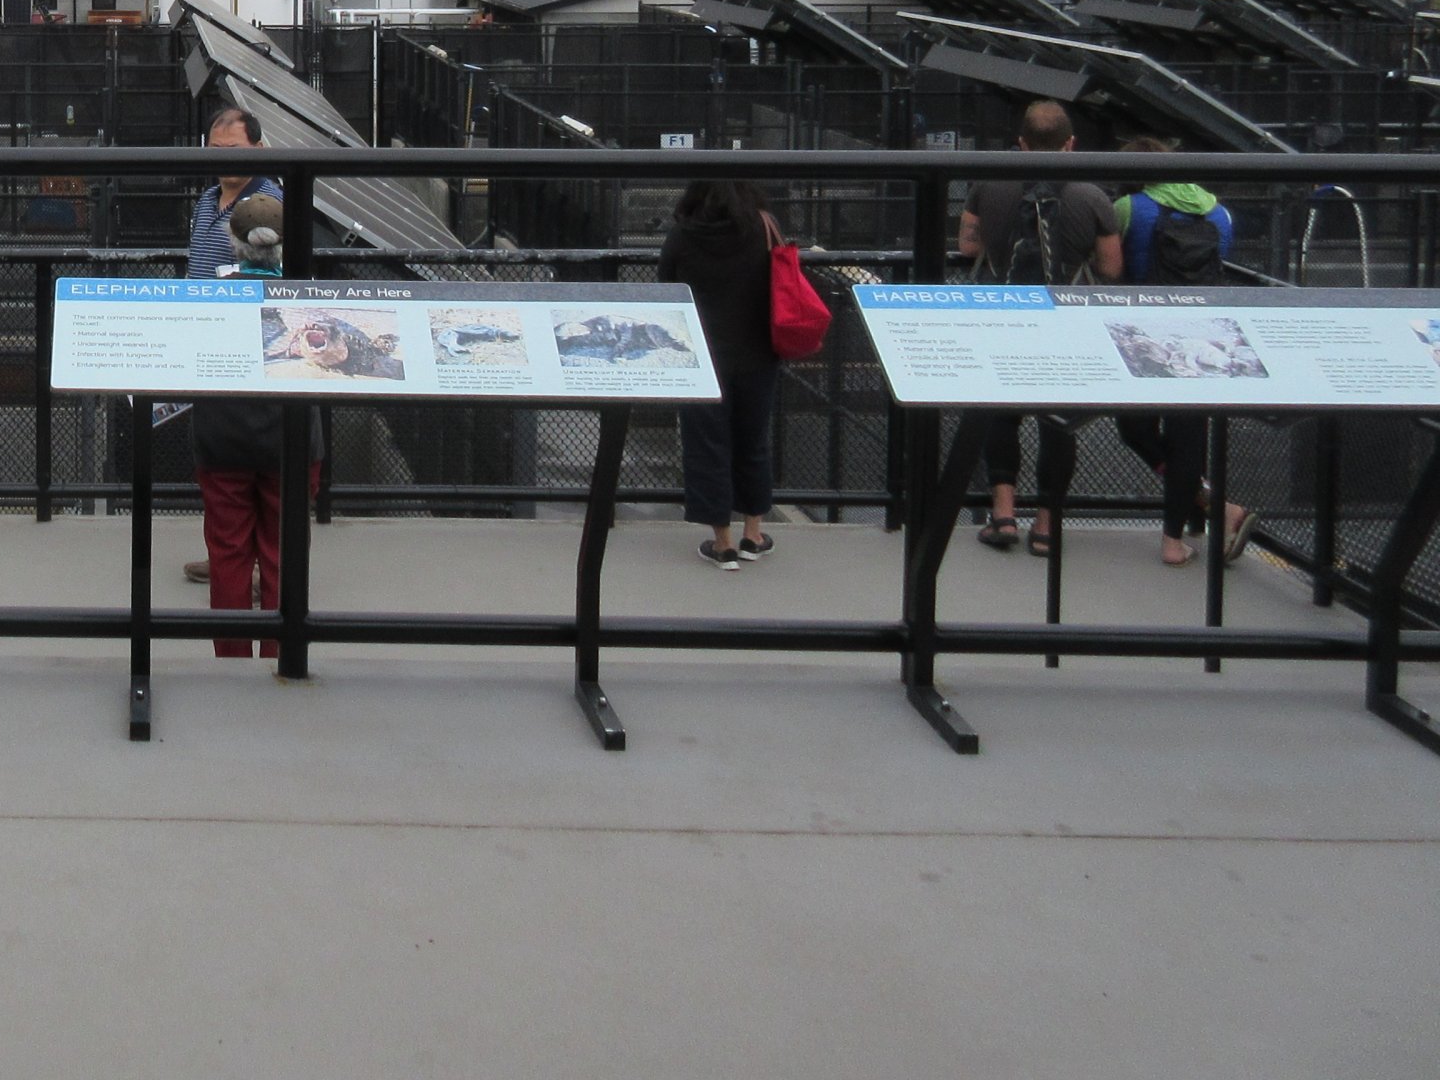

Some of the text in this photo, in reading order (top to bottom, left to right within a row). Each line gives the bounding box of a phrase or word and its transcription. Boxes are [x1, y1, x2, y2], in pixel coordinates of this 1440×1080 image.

[669, 135, 686, 147] F1
[934, 132, 952, 144] F2
[71, 284, 255, 296] ELEPHANT SEALS
[268, 287, 411, 299] Why They Are Here
[873, 292, 1043, 303] HARBOR SEALS
[1055, 293, 1206, 306] Why They Are Here
